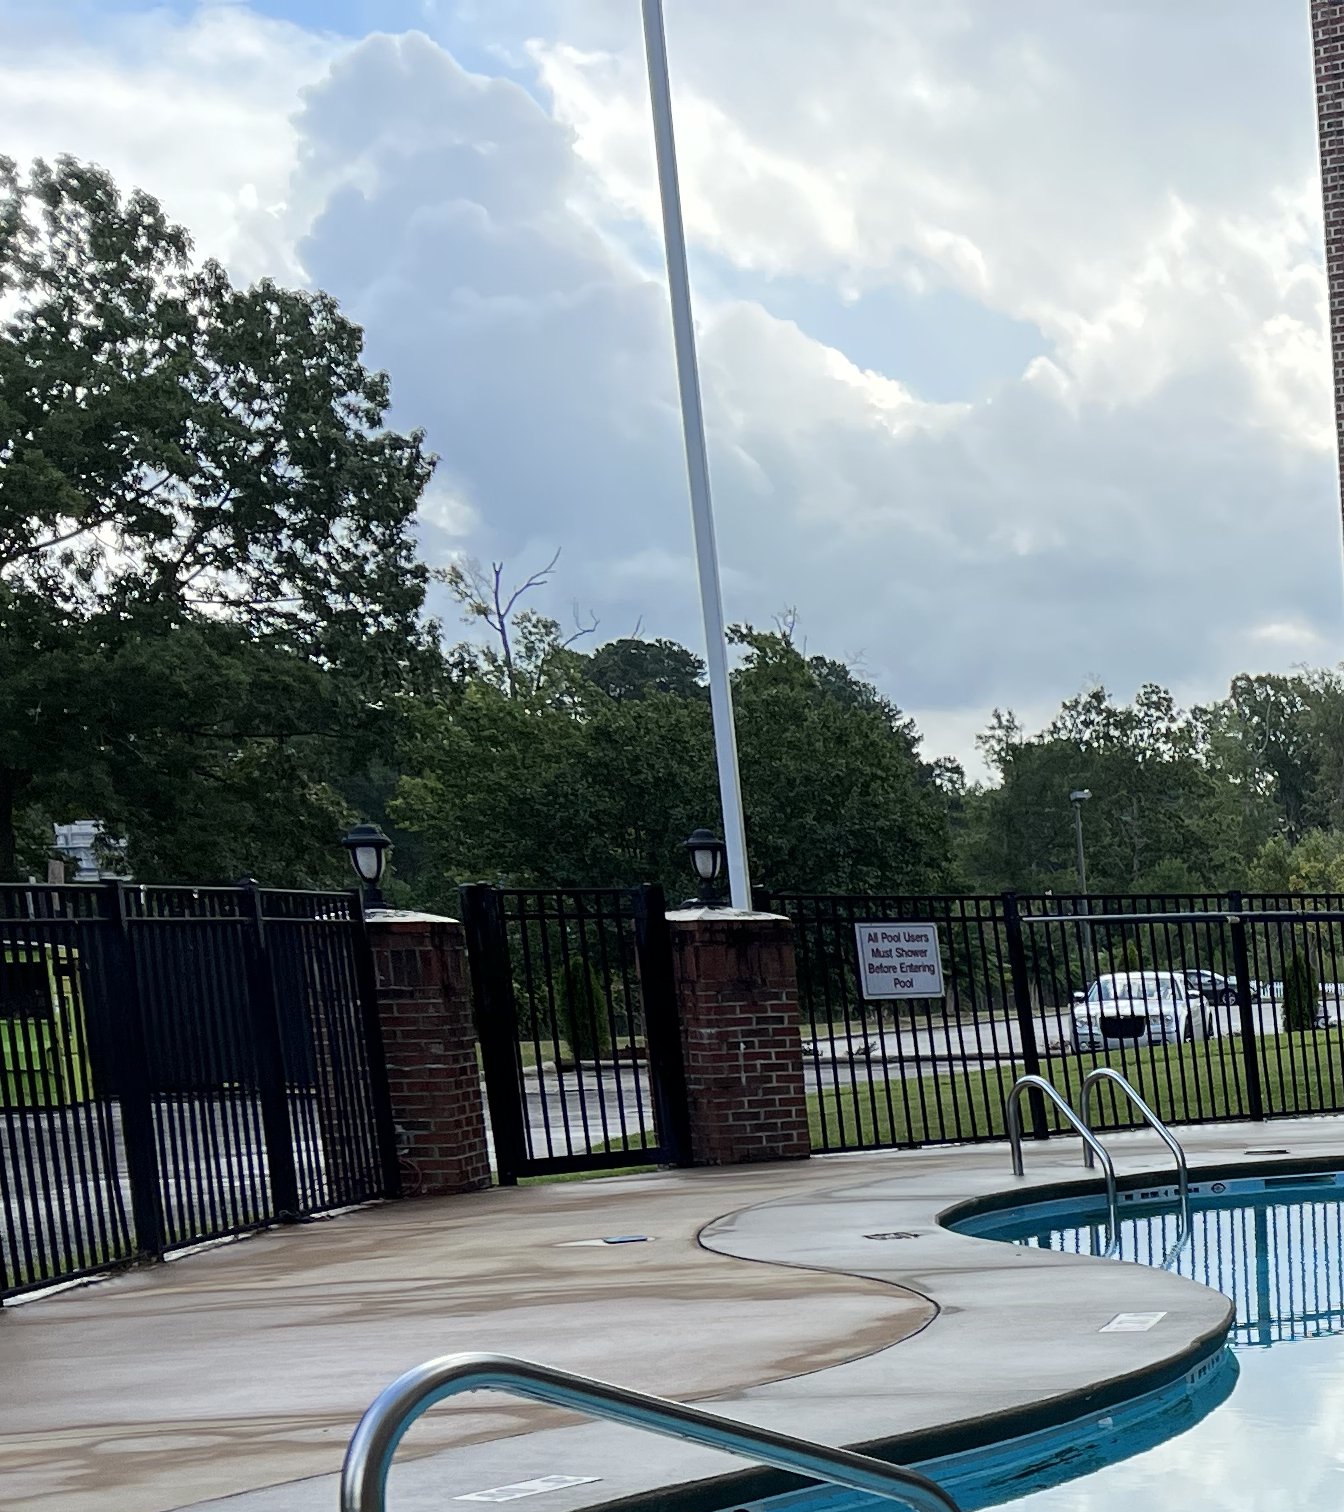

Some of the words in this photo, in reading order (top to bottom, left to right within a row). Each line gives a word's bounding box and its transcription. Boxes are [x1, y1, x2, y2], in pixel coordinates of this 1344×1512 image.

[867, 932, 879, 943] All
[881, 931, 901, 943] Pool
[902, 931, 929, 943] Users
[871, 948, 893, 959] Must
[895, 947, 928, 958] Shower
[868, 963, 897, 974] Before
[900, 962, 936, 976] Entering
[893, 978, 914, 989] Pool
